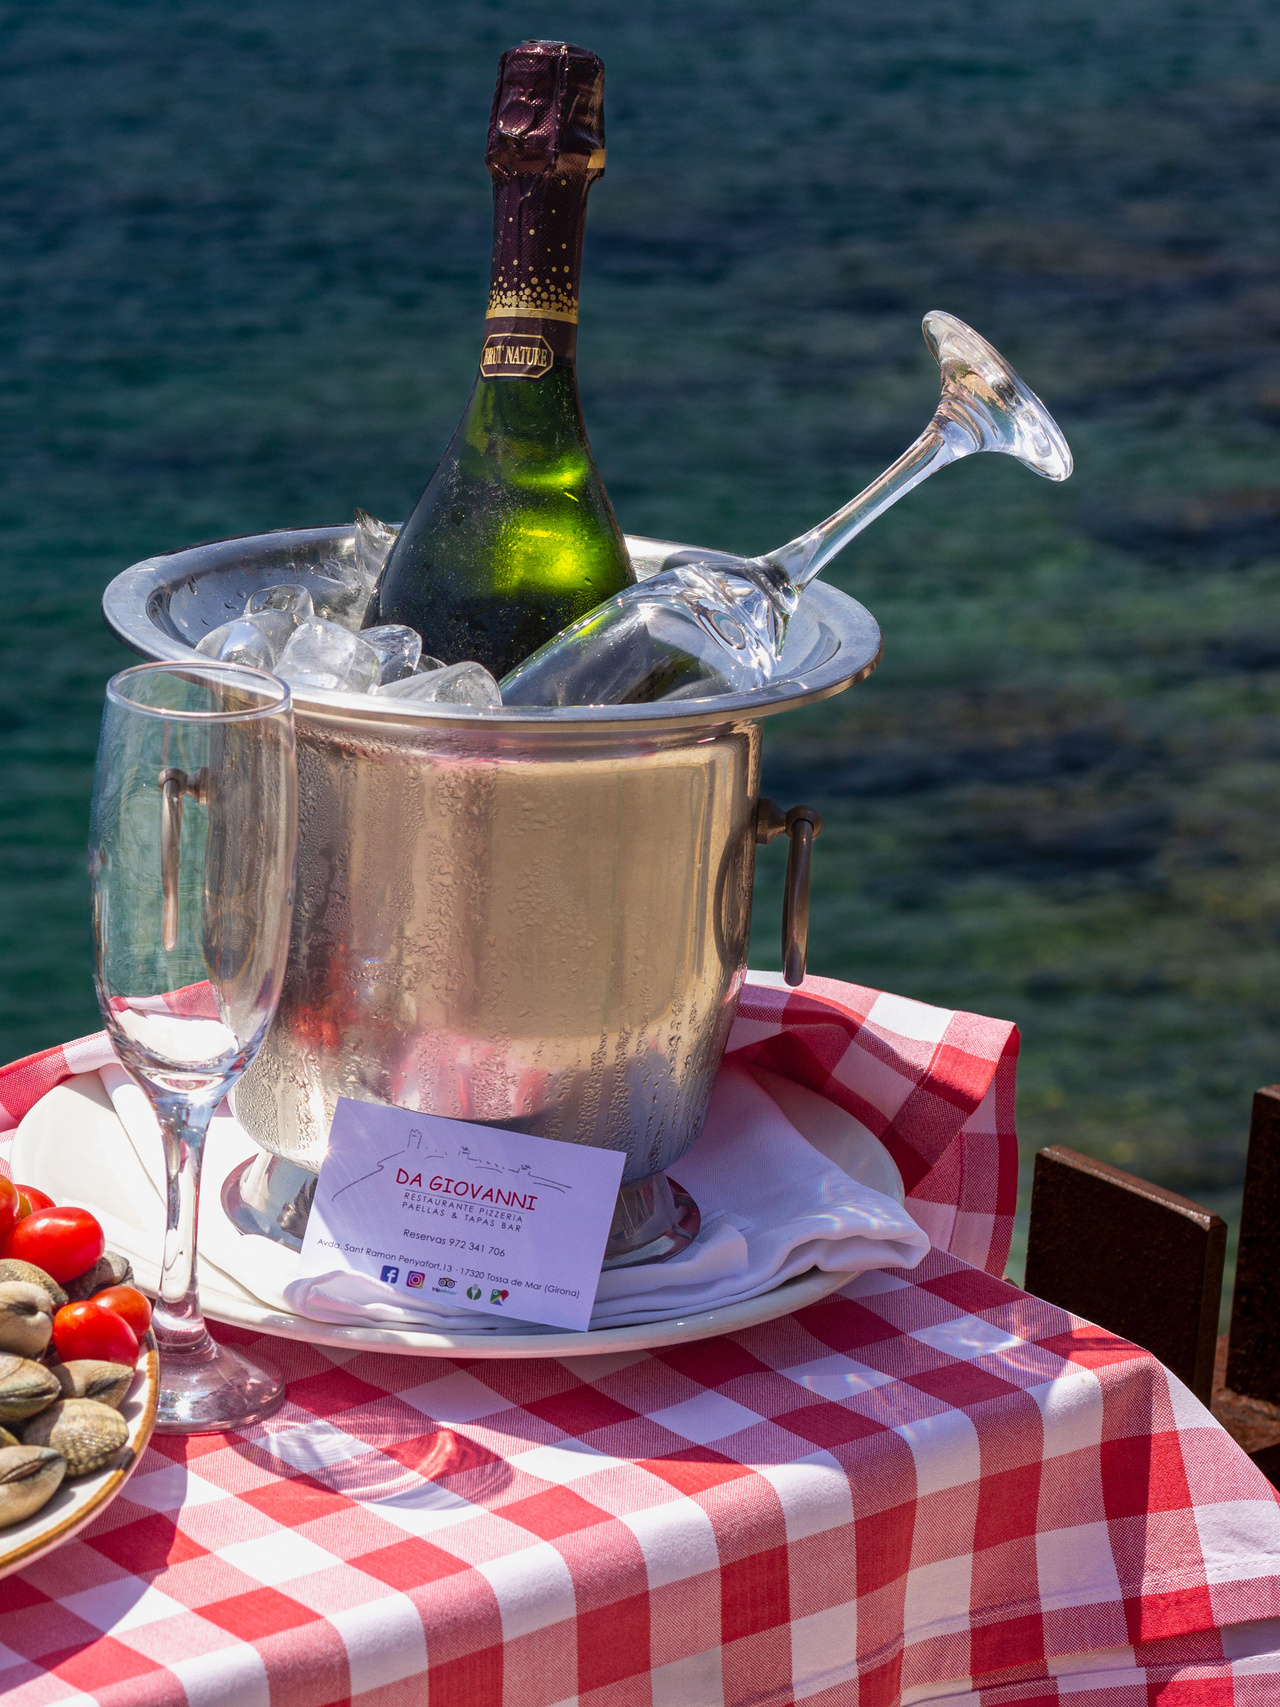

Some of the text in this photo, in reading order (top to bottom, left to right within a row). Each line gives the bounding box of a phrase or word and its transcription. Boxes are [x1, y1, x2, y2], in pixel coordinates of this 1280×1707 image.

[504, 346, 548, 367] NATURE
[396, 1168, 538, 1210] DA GIOVANNI
[402, 1202, 445, 1216] PAELLAS
[464, 1214, 494, 1226] TAPAS
[501, 1222, 521, 1232] BAR
[404, 1192, 522, 1222] RESTAURANTE PIZZERIA
[403, 1229, 505, 1257] Reservas 972 341 706
[317, 1239, 342, 1250] Avda.
[344, 1244, 364, 1254] Sant
[366, 1248, 396, 1260] Ramon
[460, 1268, 484, 1279] 17320
[487, 1273, 508, 1284] Tossa
[511, 1278, 522, 1287] de
[524, 1282, 542, 1290] Mar
[544, 1284, 580, 1298] (Girona)
